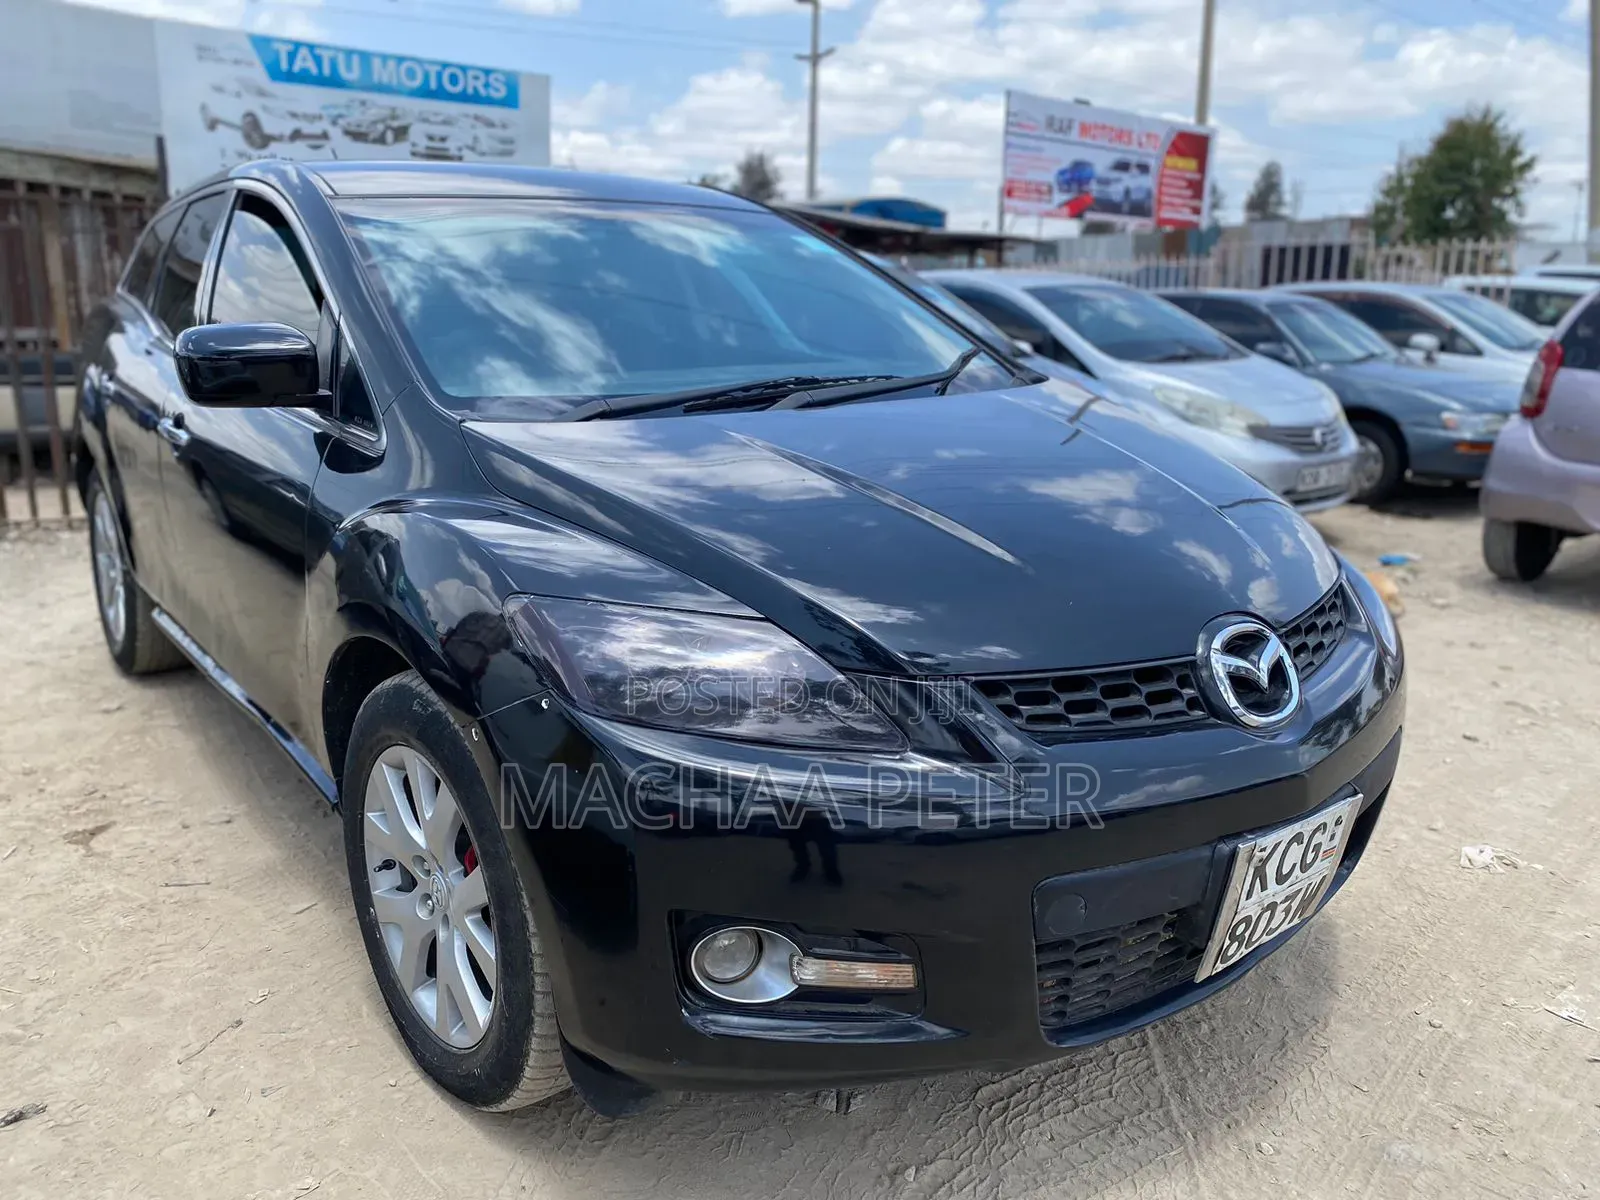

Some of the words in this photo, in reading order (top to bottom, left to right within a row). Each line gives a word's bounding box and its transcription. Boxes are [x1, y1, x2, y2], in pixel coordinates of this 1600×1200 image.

[270, 41, 361, 81] TATU
[371, 58, 508, 99] MOTORS
[1245, 821, 1328, 901] KCG
[1219, 873, 1327, 965] 803W
